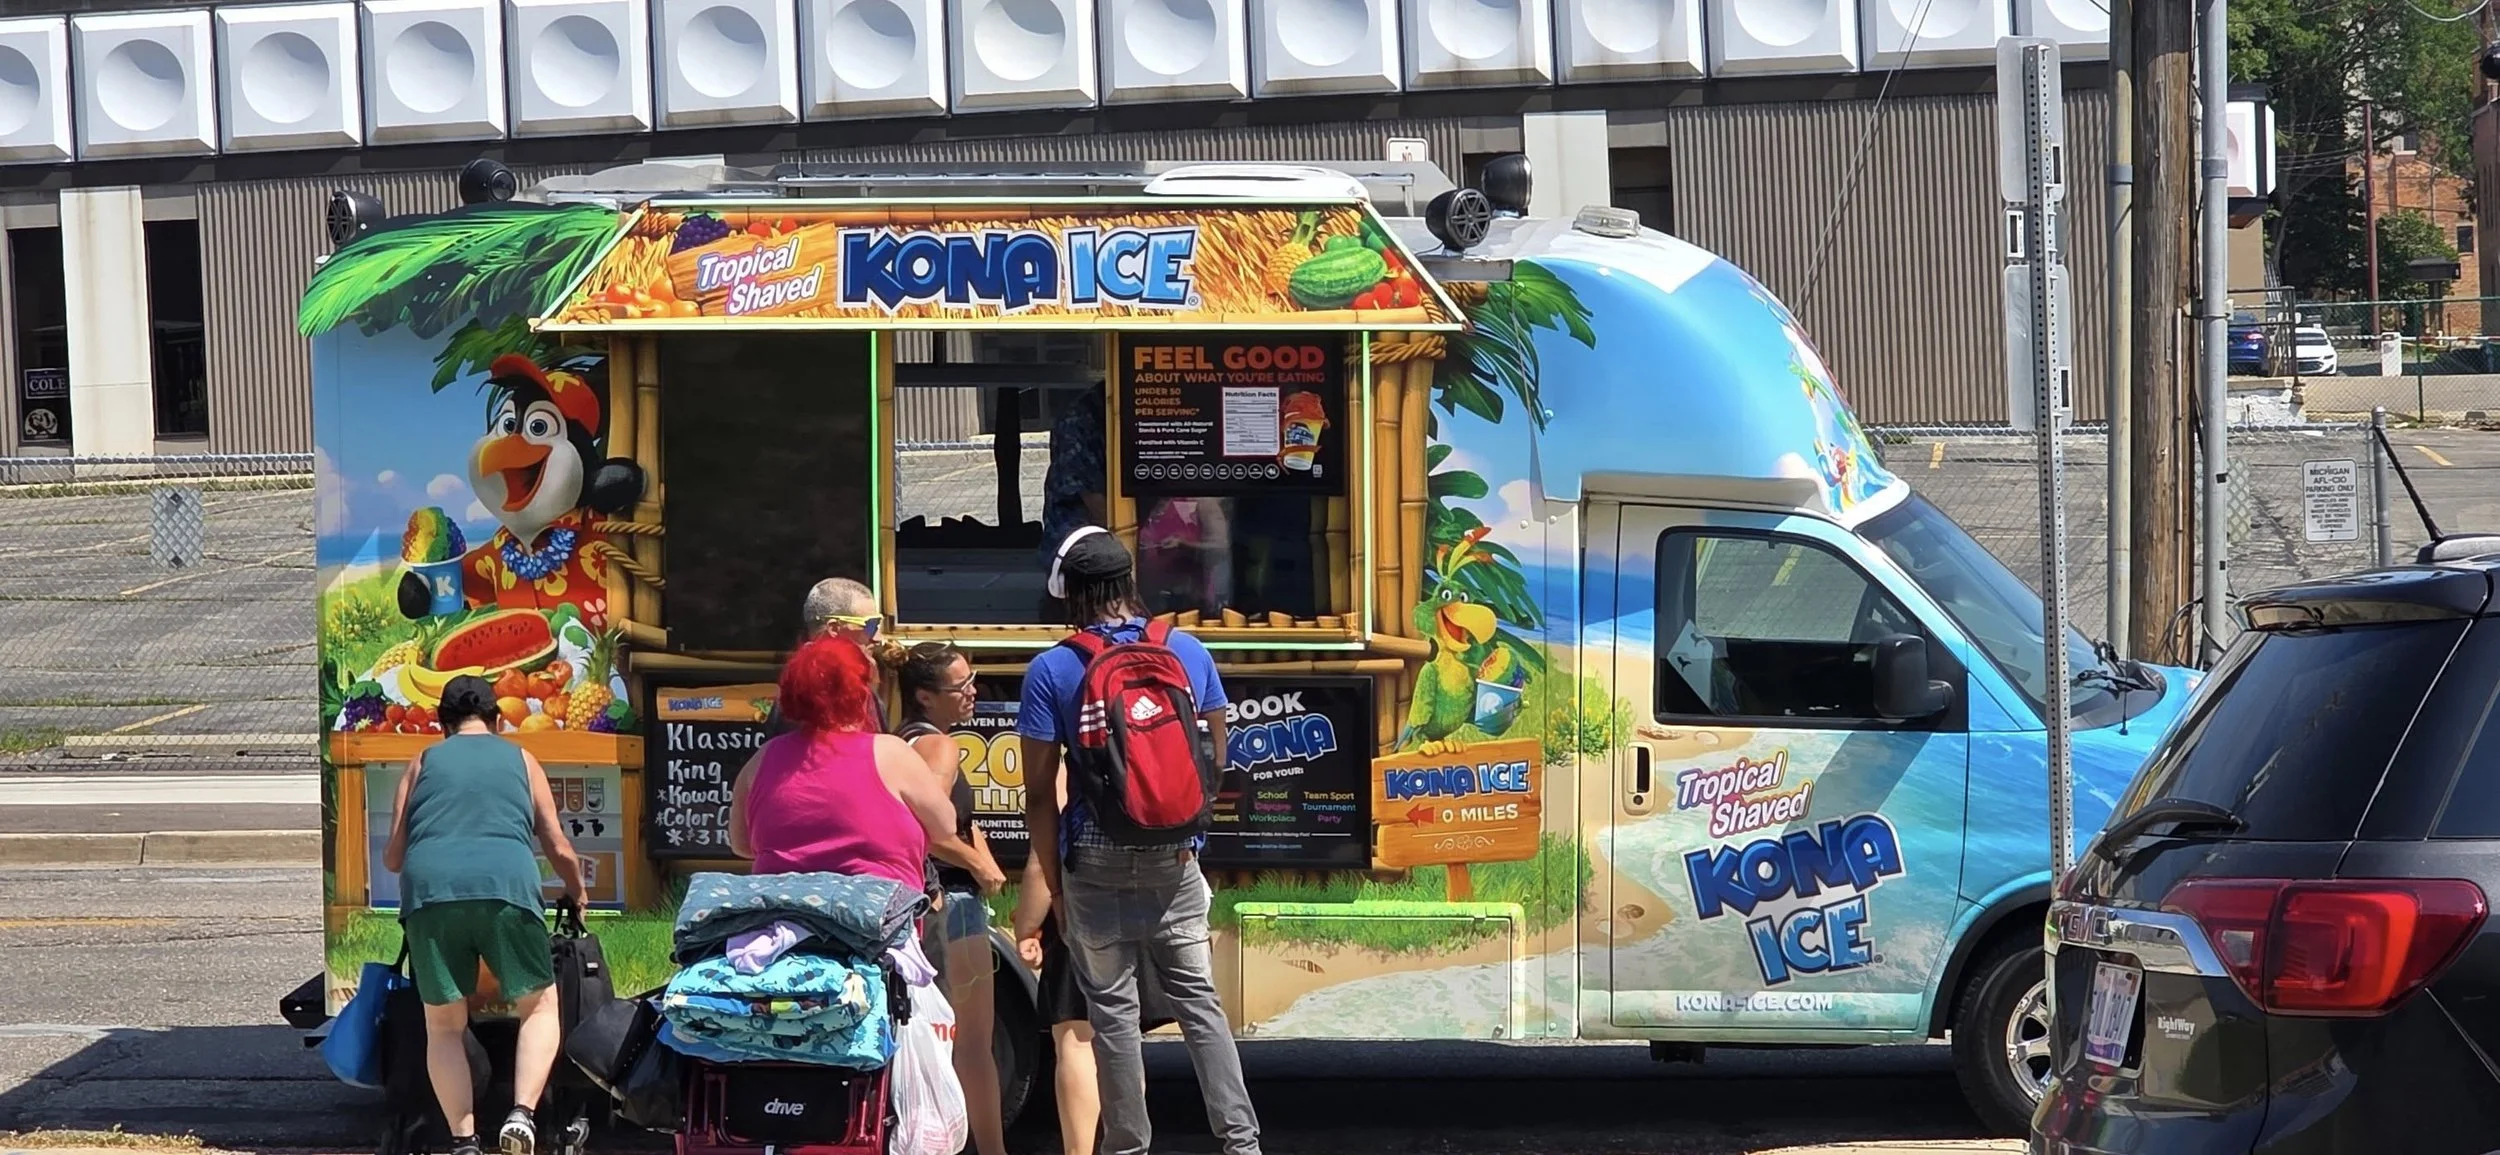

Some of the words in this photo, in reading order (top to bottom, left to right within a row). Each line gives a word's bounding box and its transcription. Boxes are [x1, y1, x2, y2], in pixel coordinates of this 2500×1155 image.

[700, 236, 798, 288] Tropical
[843, 230, 1058, 310] KONA
[1068, 230, 1195, 306] ICE
[728, 266, 820, 314] Shaved
[1134, 346, 1214, 370] FEEL
[1223, 345, 1325, 370] GOOD
[29, 378, 66, 391] COLE
[1135, 373, 1180, 383] ABOUT
[1184, 373, 1224, 383] WHAT
[1227, 373, 1274, 383] YOU'RE
[1278, 373, 1325, 383] EATING
[1135, 387, 1168, 395] UNDER
[1170, 387, 1181, 395] 50
[1135, 408, 1154, 416] PER
[2309, 467, 2350, 476] MICHIGAN
[2313, 476, 2347, 484] AFL-CIO
[2305, 485, 2335, 493] PARKING
[435, 576, 455, 596] K
[1226, 691, 1306, 723] BOOK
[667, 723, 766, 751] Klassic
[1226, 714, 1337, 771] KONA
[948, 731, 1024, 788] 20
[668, 759, 722, 784] King
[1253, 771, 1273, 781] FOR
[1385, 766, 1476, 800] KONA
[1477, 761, 1530, 793] ICE
[1679, 752, 1785, 806] Tropical
[1257, 791, 1288, 800] School
[1304, 791, 1329, 800] Team
[1331, 791, 1355, 801] Sport
[1302, 802, 1357, 812] Tournament
[1442, 809, 1453, 823] 0
[1461, 803, 1519, 822] MILES
[1711, 783, 1812, 836] Shaved
[664, 807, 714, 828] Color
[1249, 813, 1296, 823] Workplace
[1317, 814, 1342, 824] Party
[1685, 816, 1905, 918] KONA
[1747, 894, 1874, 985] ICE
[1676, 994, 1833, 1012] KONA-ICE.COM
[2157, 1016, 2195, 1035] RightWay
[764, 1098, 806, 1116] drive
